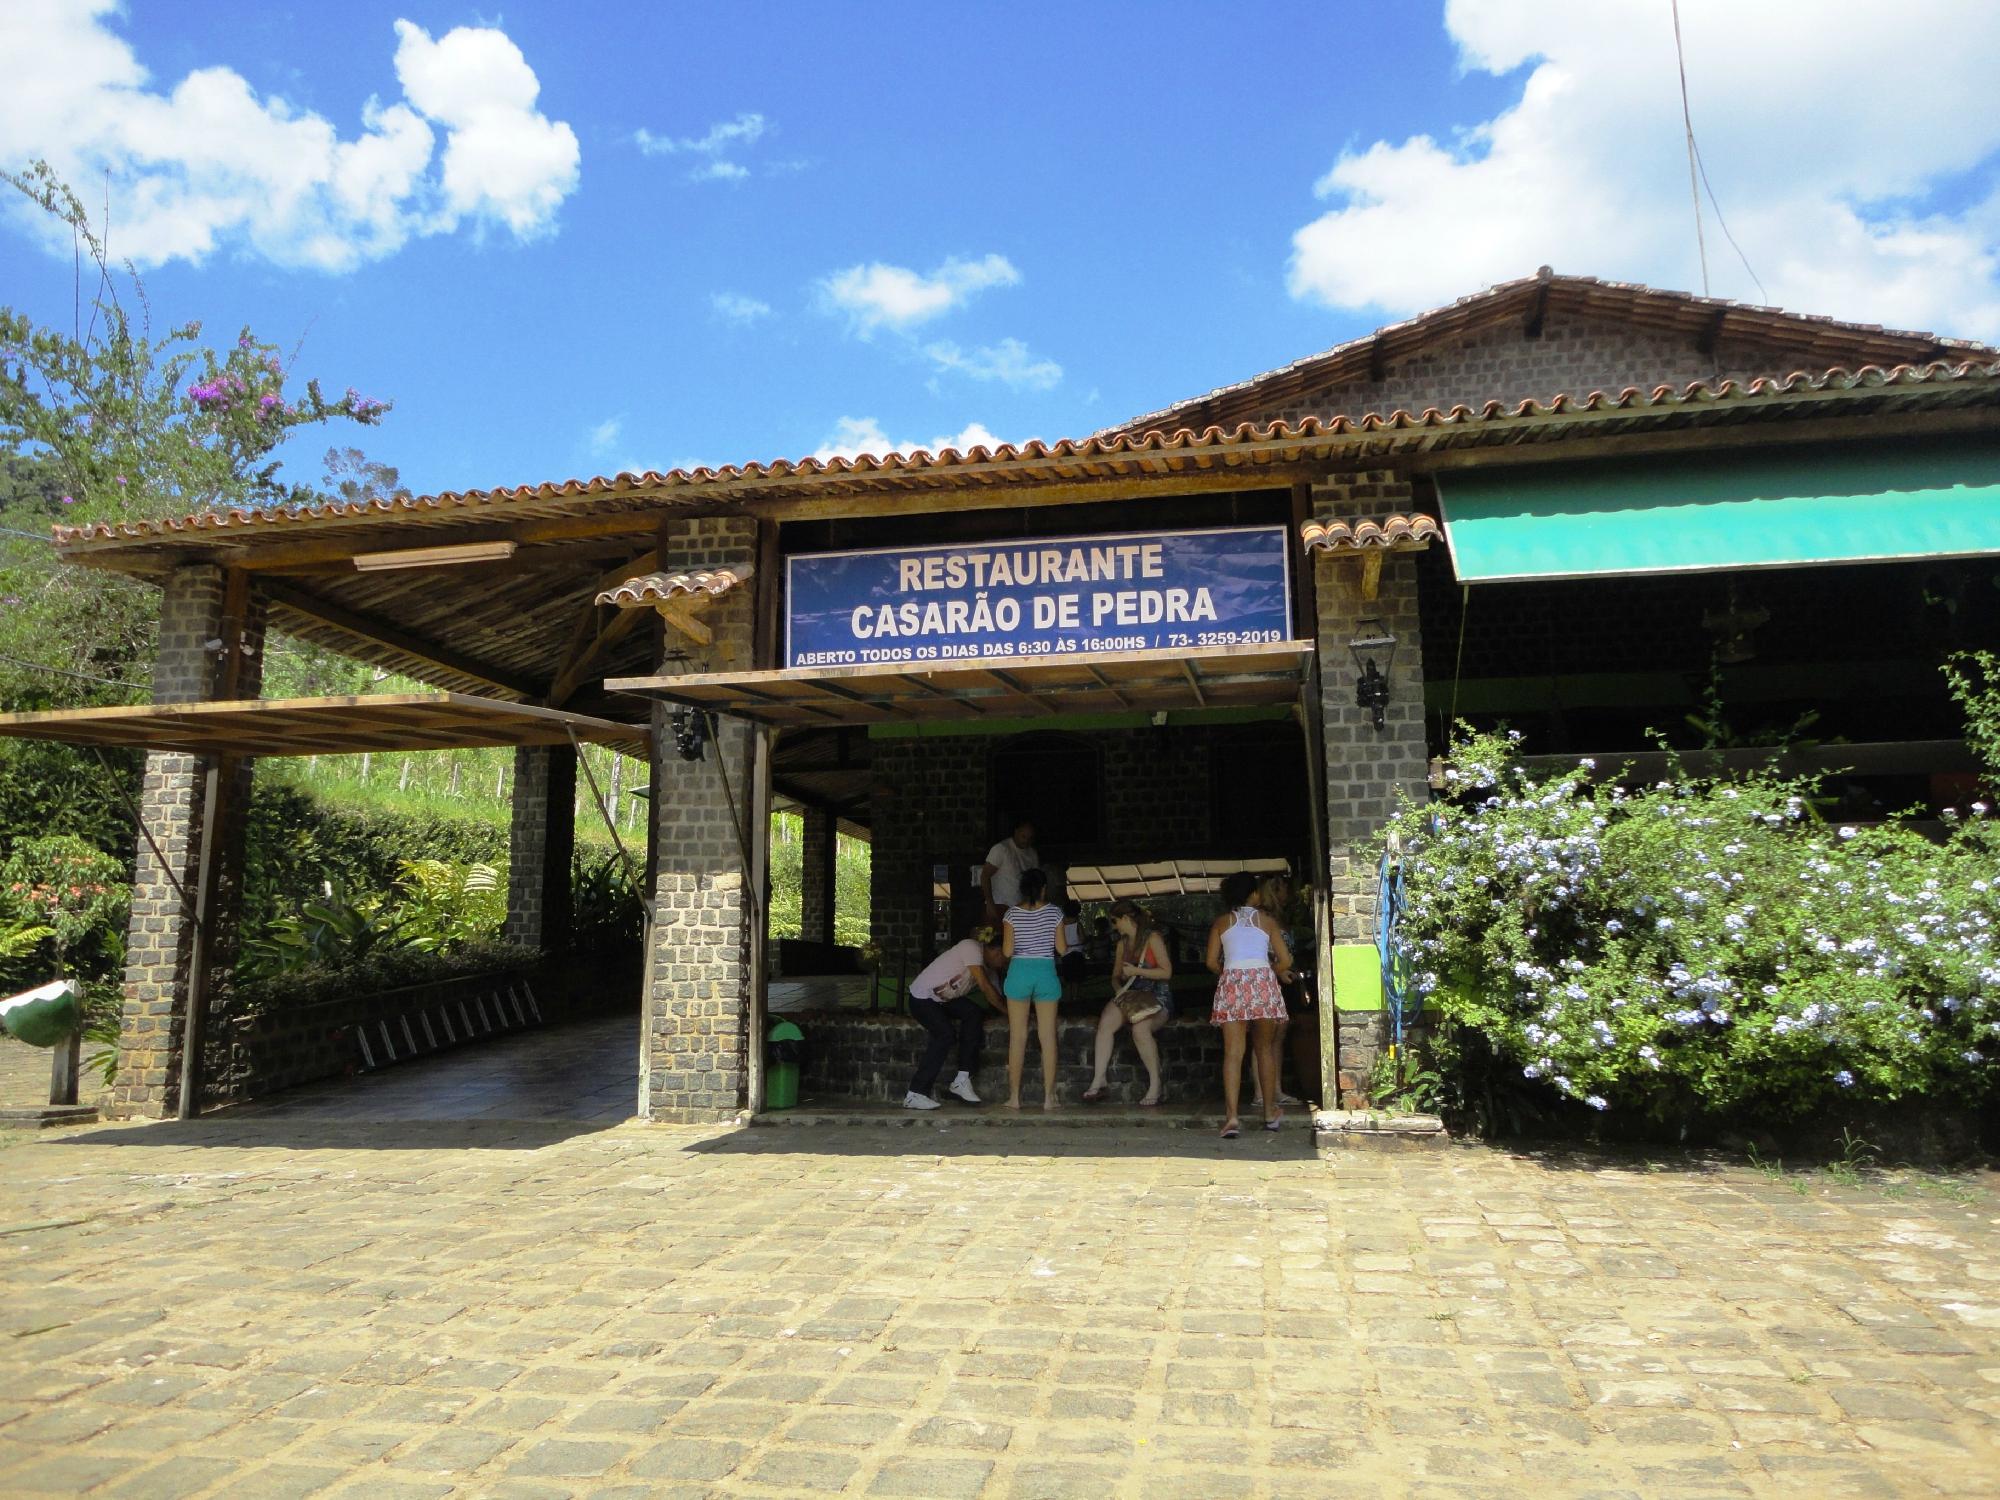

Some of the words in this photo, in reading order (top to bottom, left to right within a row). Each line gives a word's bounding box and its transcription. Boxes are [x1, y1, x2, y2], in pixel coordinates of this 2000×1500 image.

[900, 544, 1163, 592] RESTAURANTE
[852, 591, 1020, 639] CASARÃO
[1034, 594, 1080, 629] DE
[1093, 587, 1217, 627] PEDRA
[797, 651, 856, 665] ABERTO
[861, 648, 912, 661] TODOS
[917, 647, 937, 659] OS
[942, 644, 979, 657] DIAS
[984, 643, 1013, 655] DAS
[1019, 641, 1050, 654] 6:30
[1055, 637, 1076, 652] ÀS
[1082, 637, 1145, 650] 16:00HS
[1198, 630, 1281, 645] 3259-2019
